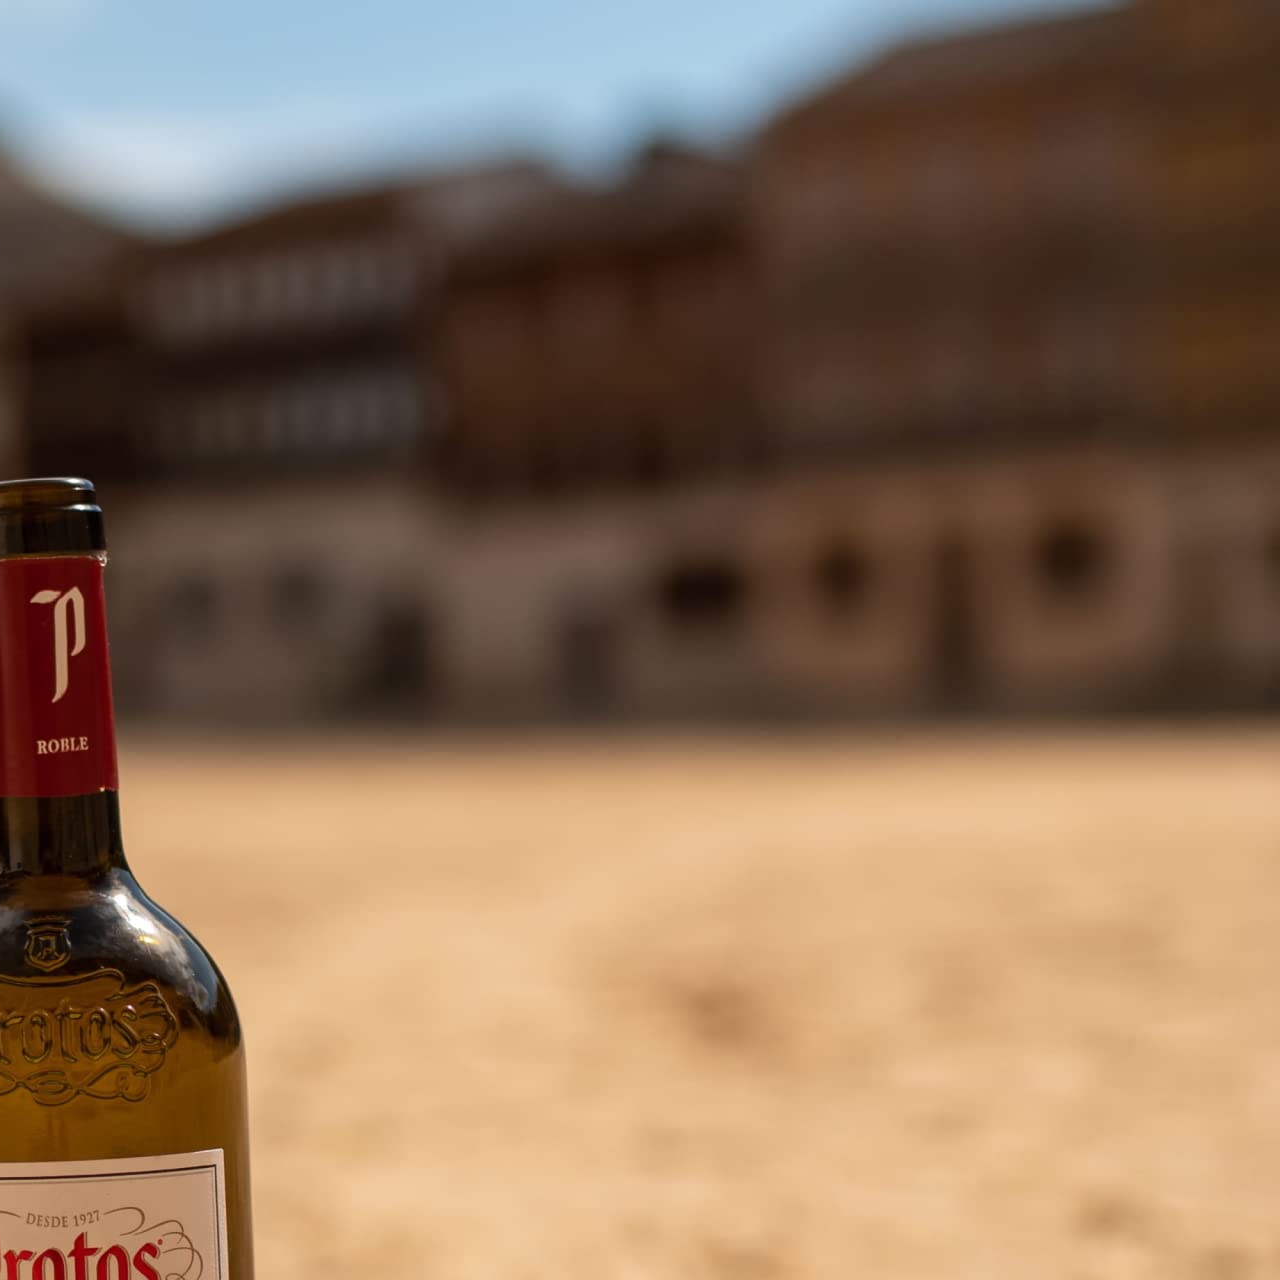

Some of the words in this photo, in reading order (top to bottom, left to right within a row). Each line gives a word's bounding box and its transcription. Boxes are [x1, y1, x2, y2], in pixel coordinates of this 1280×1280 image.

[29, 585, 86, 704] P
[36, 736, 89, 755] ROBLE
[26, 1212, 69, 1228] DESDE
[73, 1209, 100, 1227] 1927
